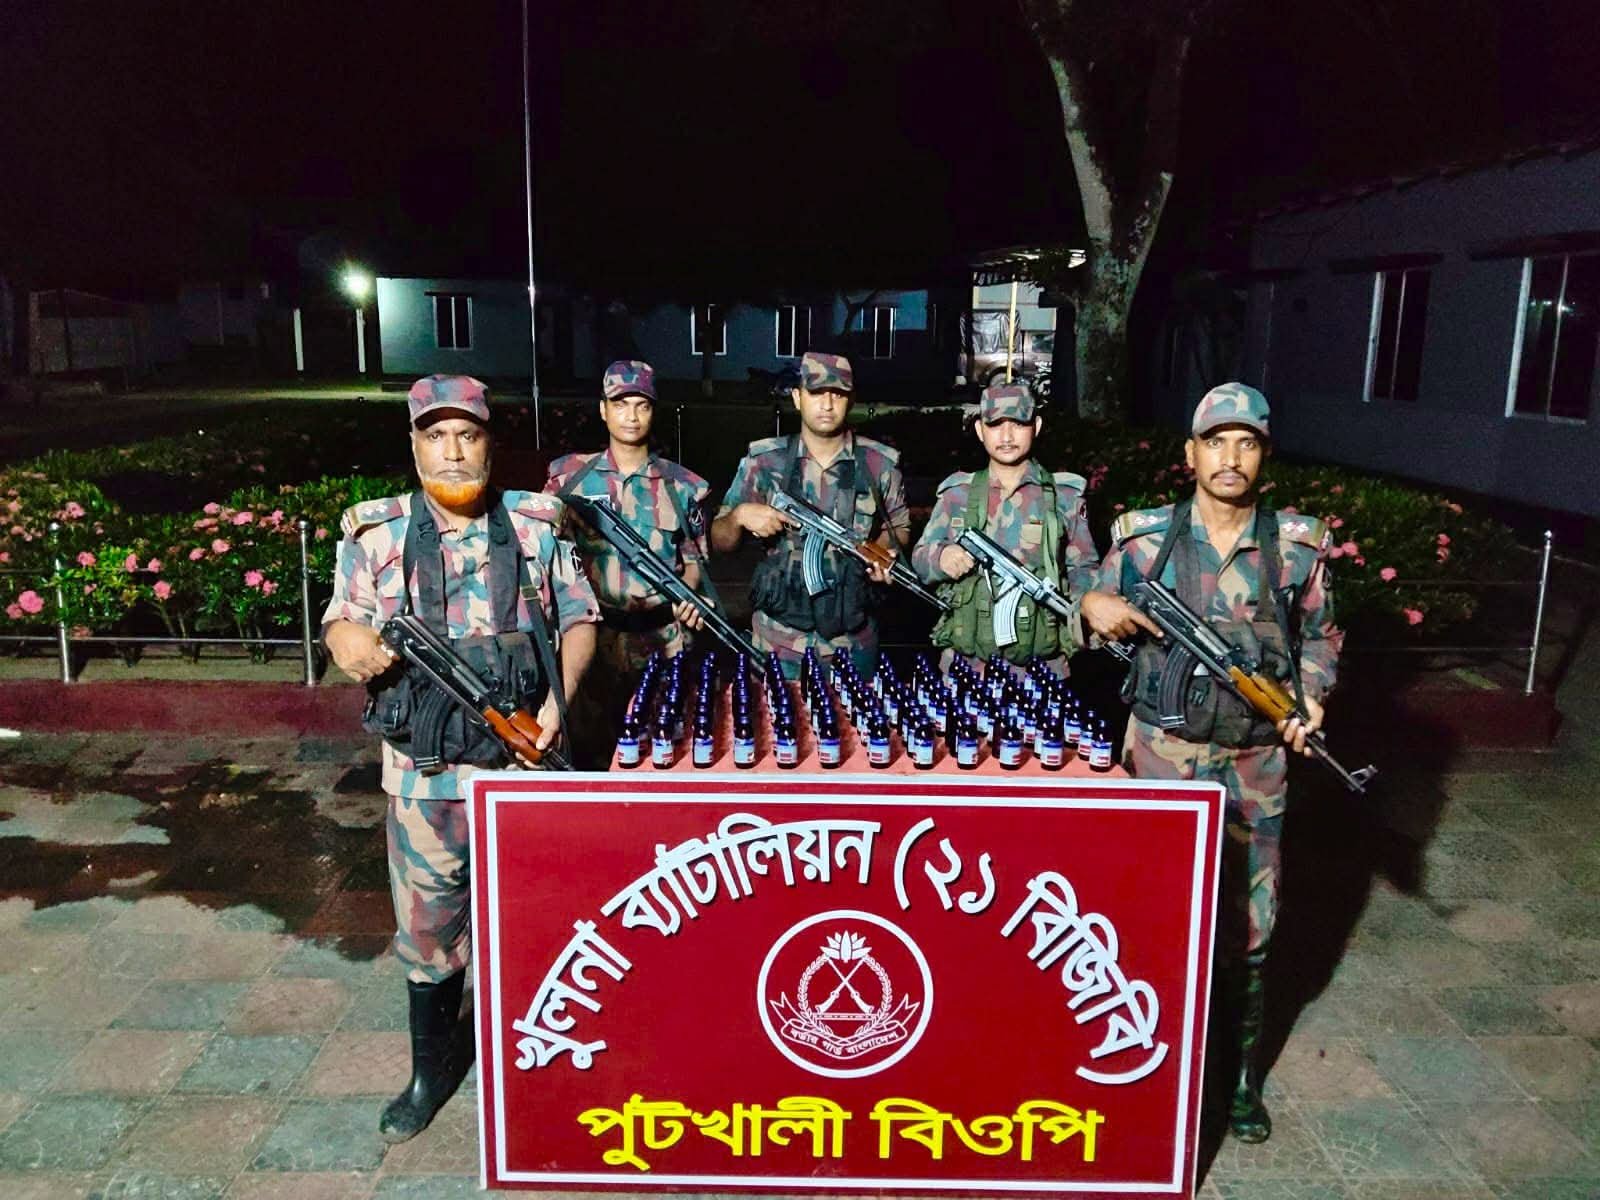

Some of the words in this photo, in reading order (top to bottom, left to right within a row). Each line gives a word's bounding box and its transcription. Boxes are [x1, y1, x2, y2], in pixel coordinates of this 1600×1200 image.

[513, 920, 632, 1069] খুলনা
[600, 813, 881, 936] ব্যাটালিয়ন
[894, 818, 995, 913] (২১
[1001, 871, 1168, 1084] বিজিবি)
[577, 1094, 852, 1171] পুটখালী
[870, 1098, 1104, 1161] বিওপি
